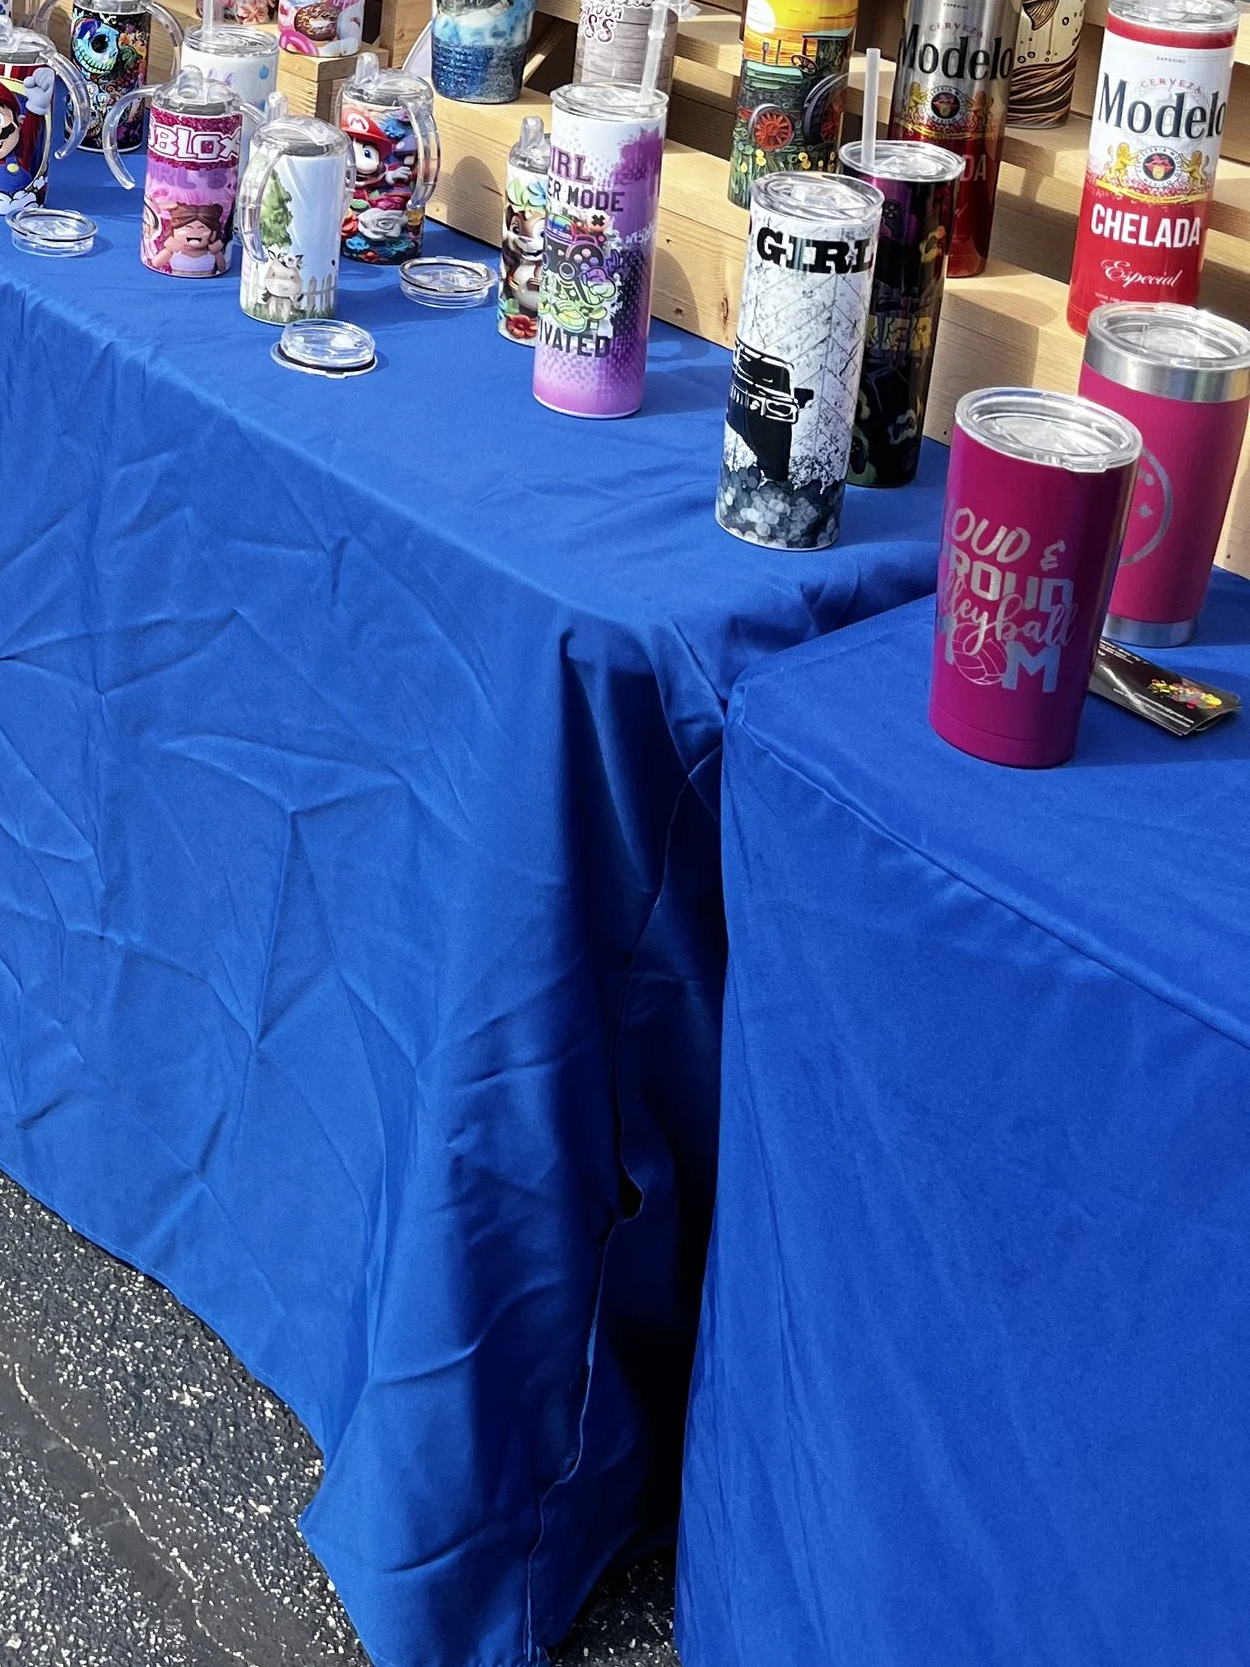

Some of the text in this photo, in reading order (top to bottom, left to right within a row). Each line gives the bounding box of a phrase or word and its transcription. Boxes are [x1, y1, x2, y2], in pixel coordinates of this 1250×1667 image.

[1097, 72, 1227, 140] Modelo
[567, 185, 626, 213] MODE
[1090, 203, 1202, 248] CHELADA
[756, 226, 874, 275] GIRL
[1100, 258, 1183, 288] Especial
